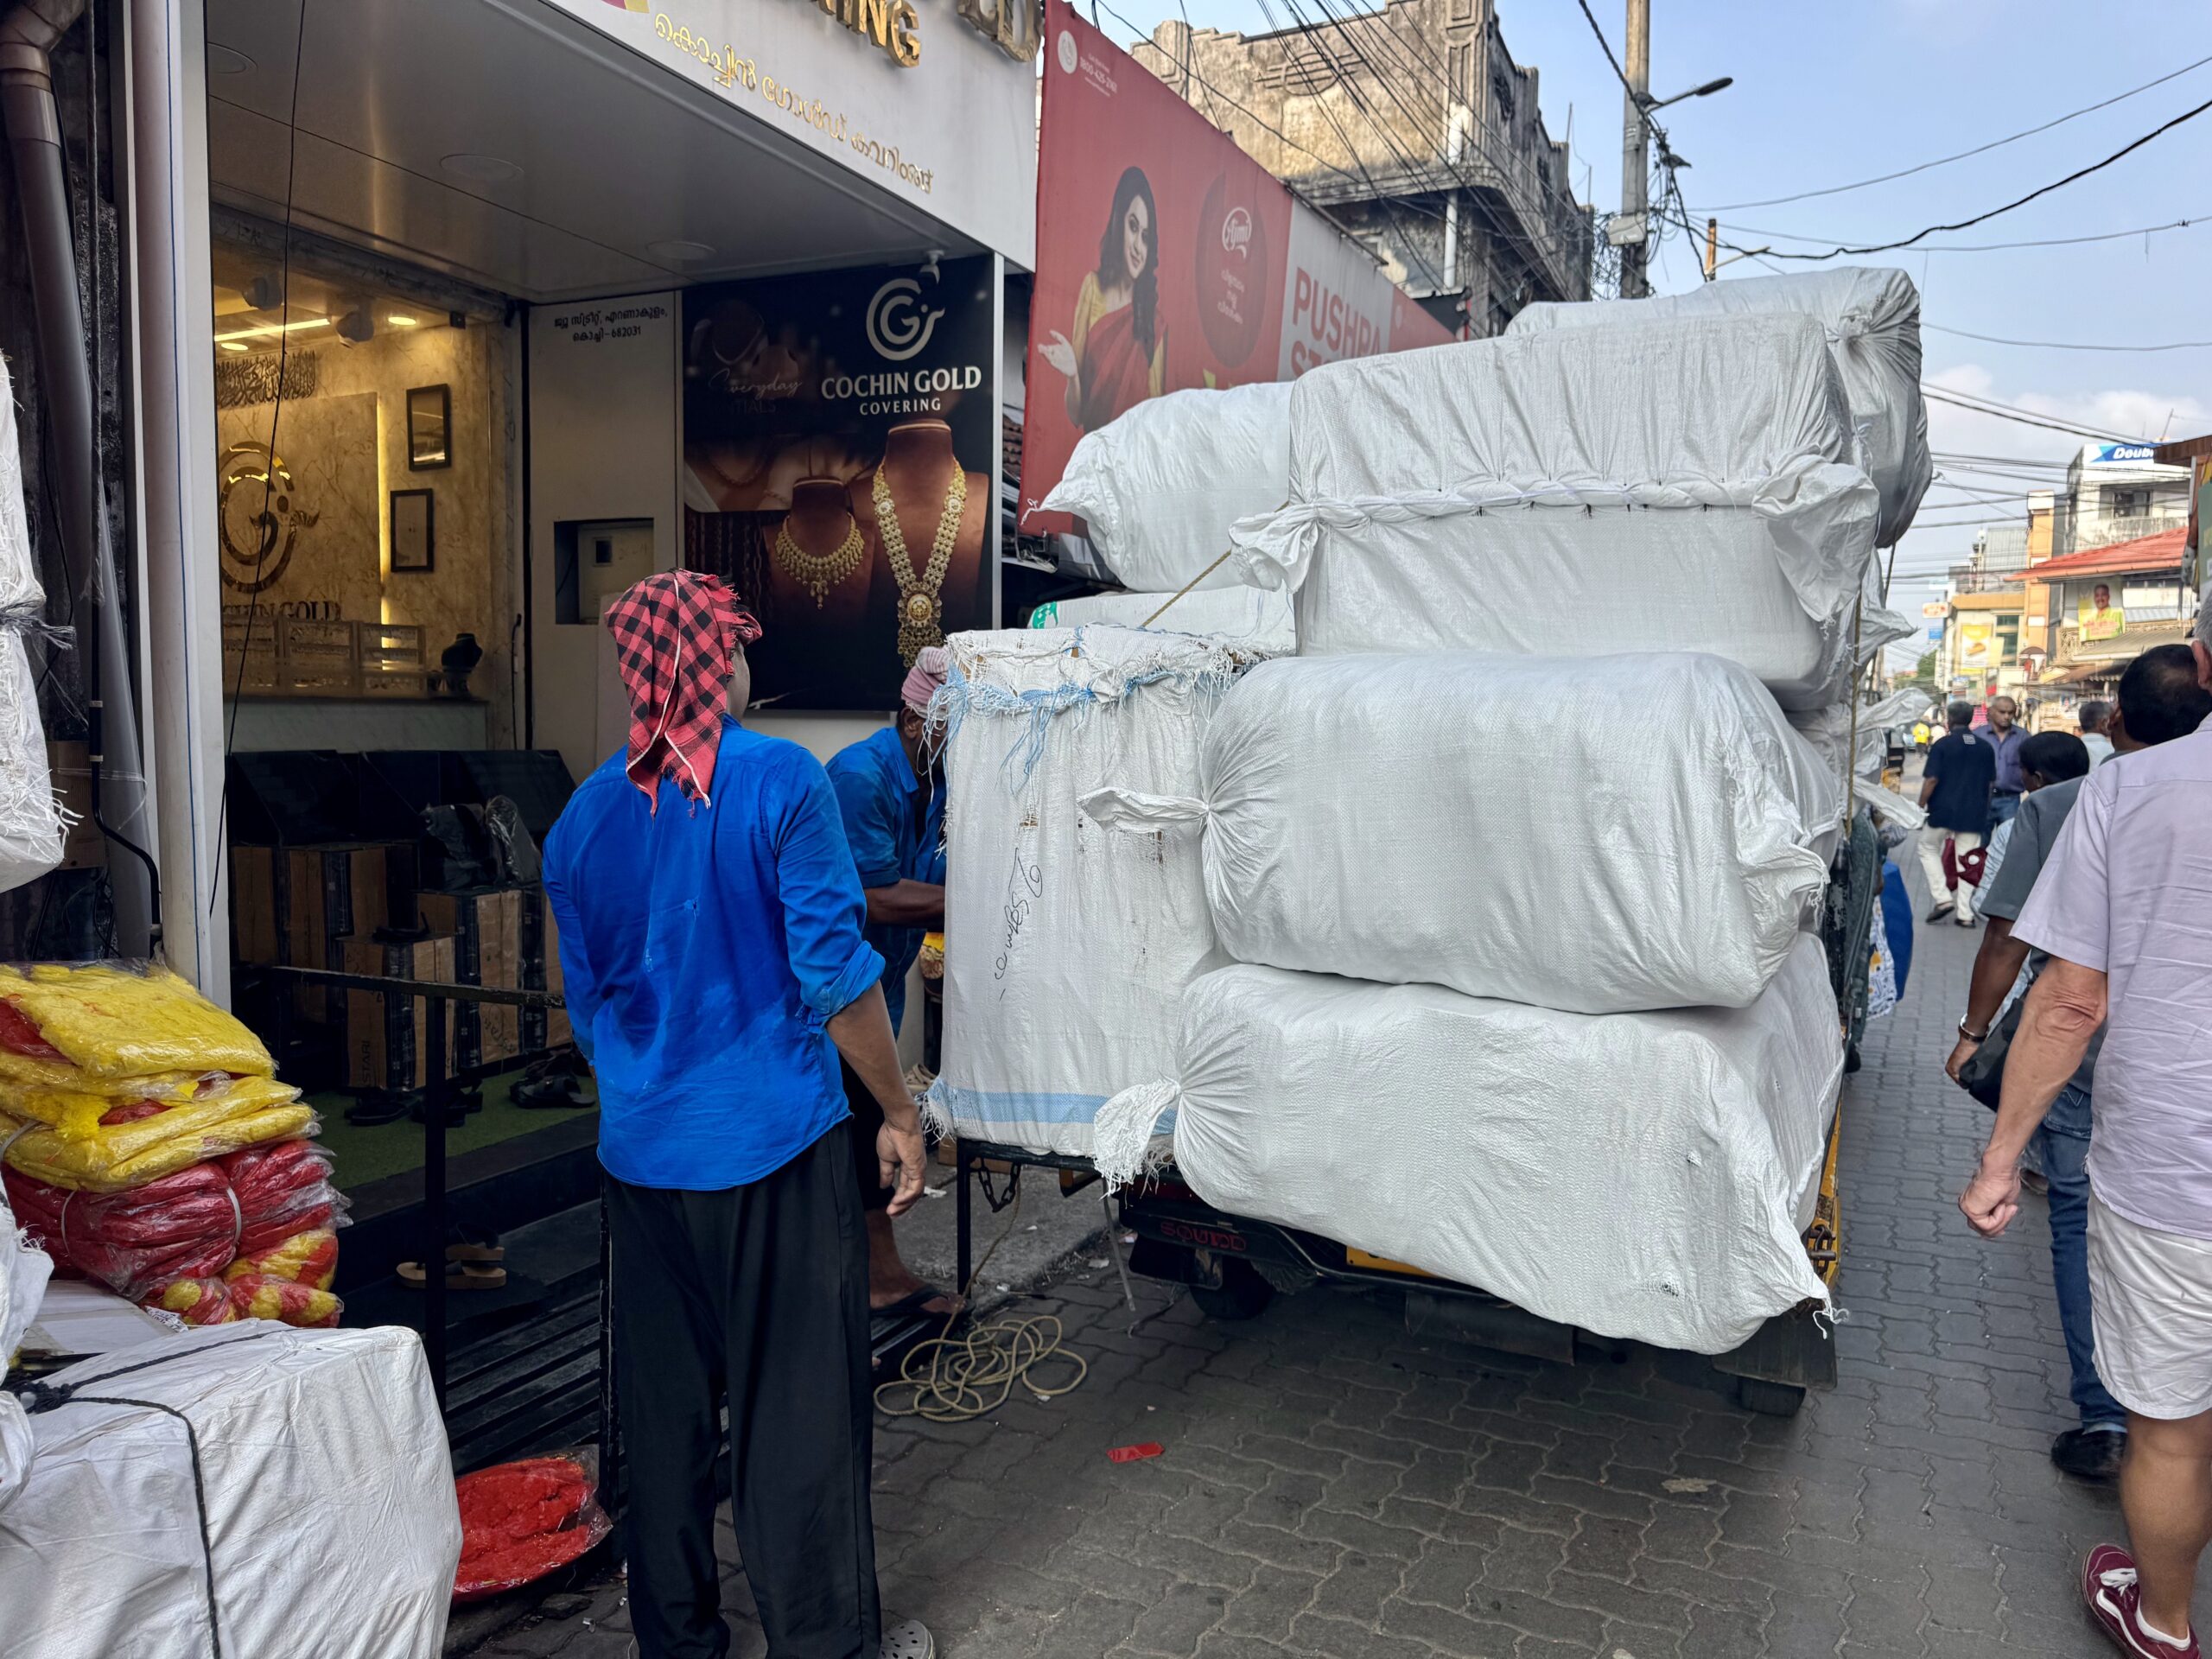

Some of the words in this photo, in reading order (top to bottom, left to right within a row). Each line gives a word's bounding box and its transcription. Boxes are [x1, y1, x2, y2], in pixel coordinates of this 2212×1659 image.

[822, 372, 909, 400] COCHIN
[914, 365, 982, 393] GOLD
[860, 397, 941, 416] COVERING
